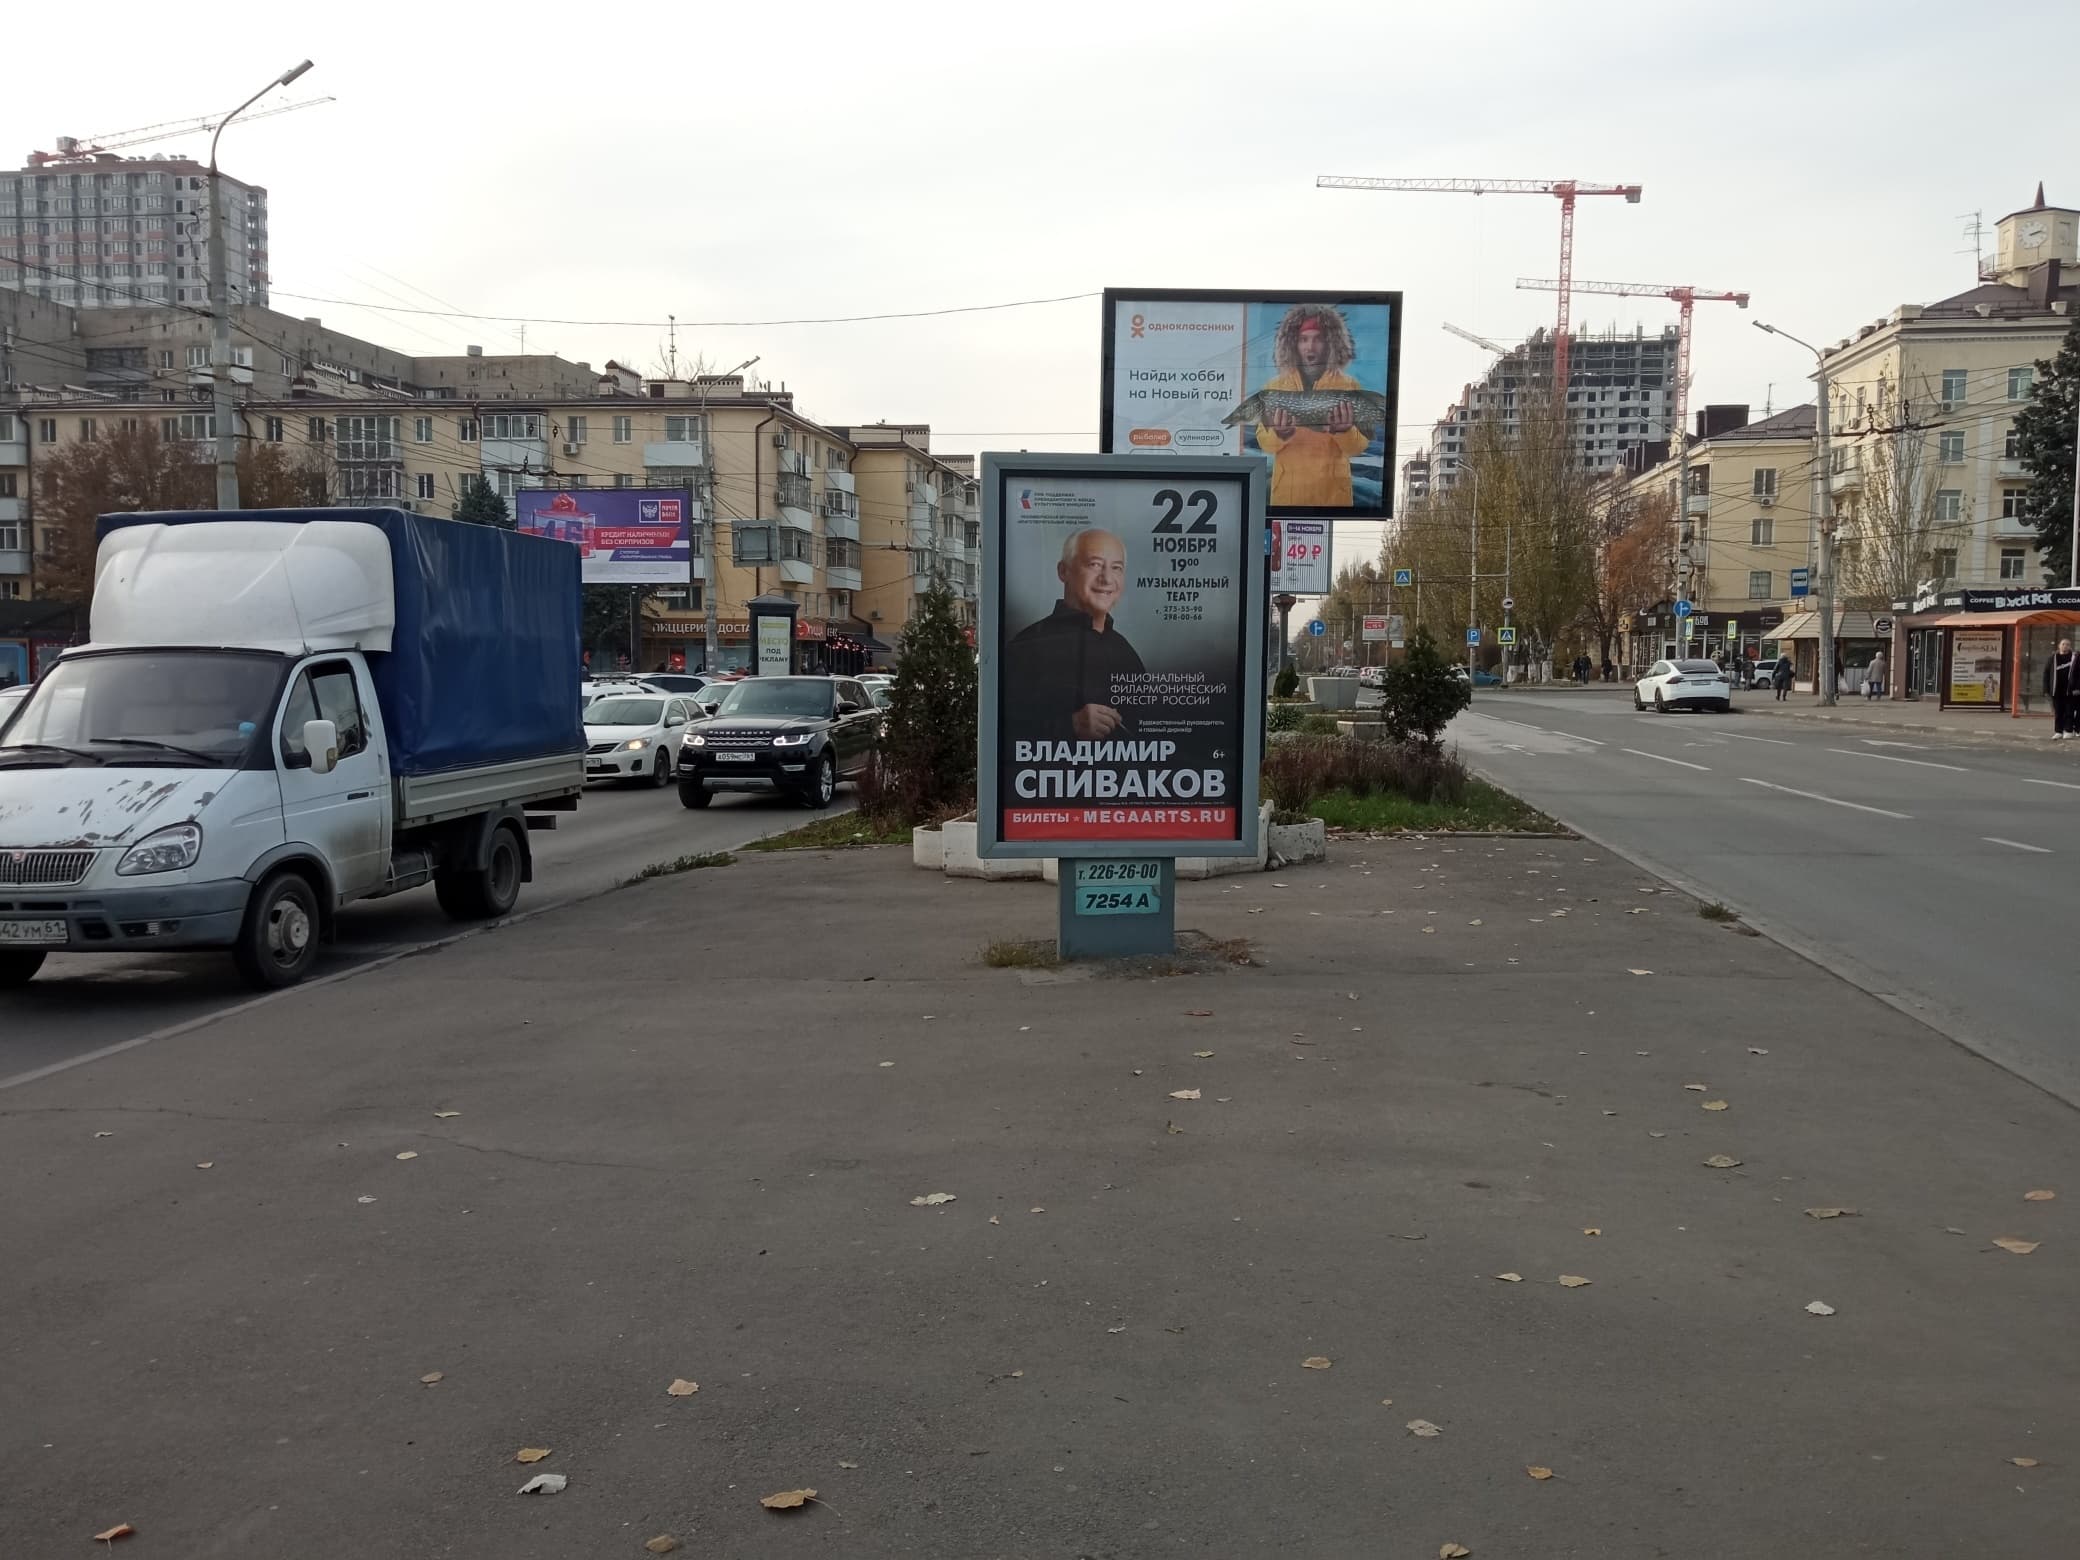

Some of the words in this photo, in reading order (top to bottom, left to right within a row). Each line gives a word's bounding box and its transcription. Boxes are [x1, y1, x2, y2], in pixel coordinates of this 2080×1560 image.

[1148, 322, 1234, 331] одноклассники
[1129, 369, 1176, 383] Найди
[1180, 369, 1225, 381] хобби
[1129, 390, 1147, 399] на
[1152, 387, 1199, 400] Новый
[1204, 389, 1232, 401] год!
[1133, 433, 1167, 442] рыбалка
[1179, 434, 1220, 443] кулинария
[1152, 489, 1218, 534] 22
[1153, 537, 1217, 553] НОЯБРЯ
[1287, 544, 1307, 559] 49
[1137, 576, 1229, 589] МУЗЫКАЛЬНЫЙ
[1167, 591, 1200, 602] ТЕАТР
[652, 623, 706, 635] ПИЦЦЕРИЯ
[1110, 671, 1205, 683] НАЦИОНАЛЬНЫЙ
[1110, 683, 1227, 694] ФИЛАРМОНИЧЕСКИЙ
[1110, 695, 1158, 705] ОРКЕСТР
[1162, 695, 1210, 705] РОССИИ
[1015, 740, 1176, 765] ВЛАДИМИР
[1212, 749, 1225, 760] 6+
[1015, 768, 1226, 799] СПИВАКОВ
[1013, 811, 1069, 824] БИЛЕТЫ
[1083, 809, 1226, 823] MEGAARTS.RU
[1088, 863, 1158, 880] 226-26-00
[1086, 893, 1133, 909] 7254
